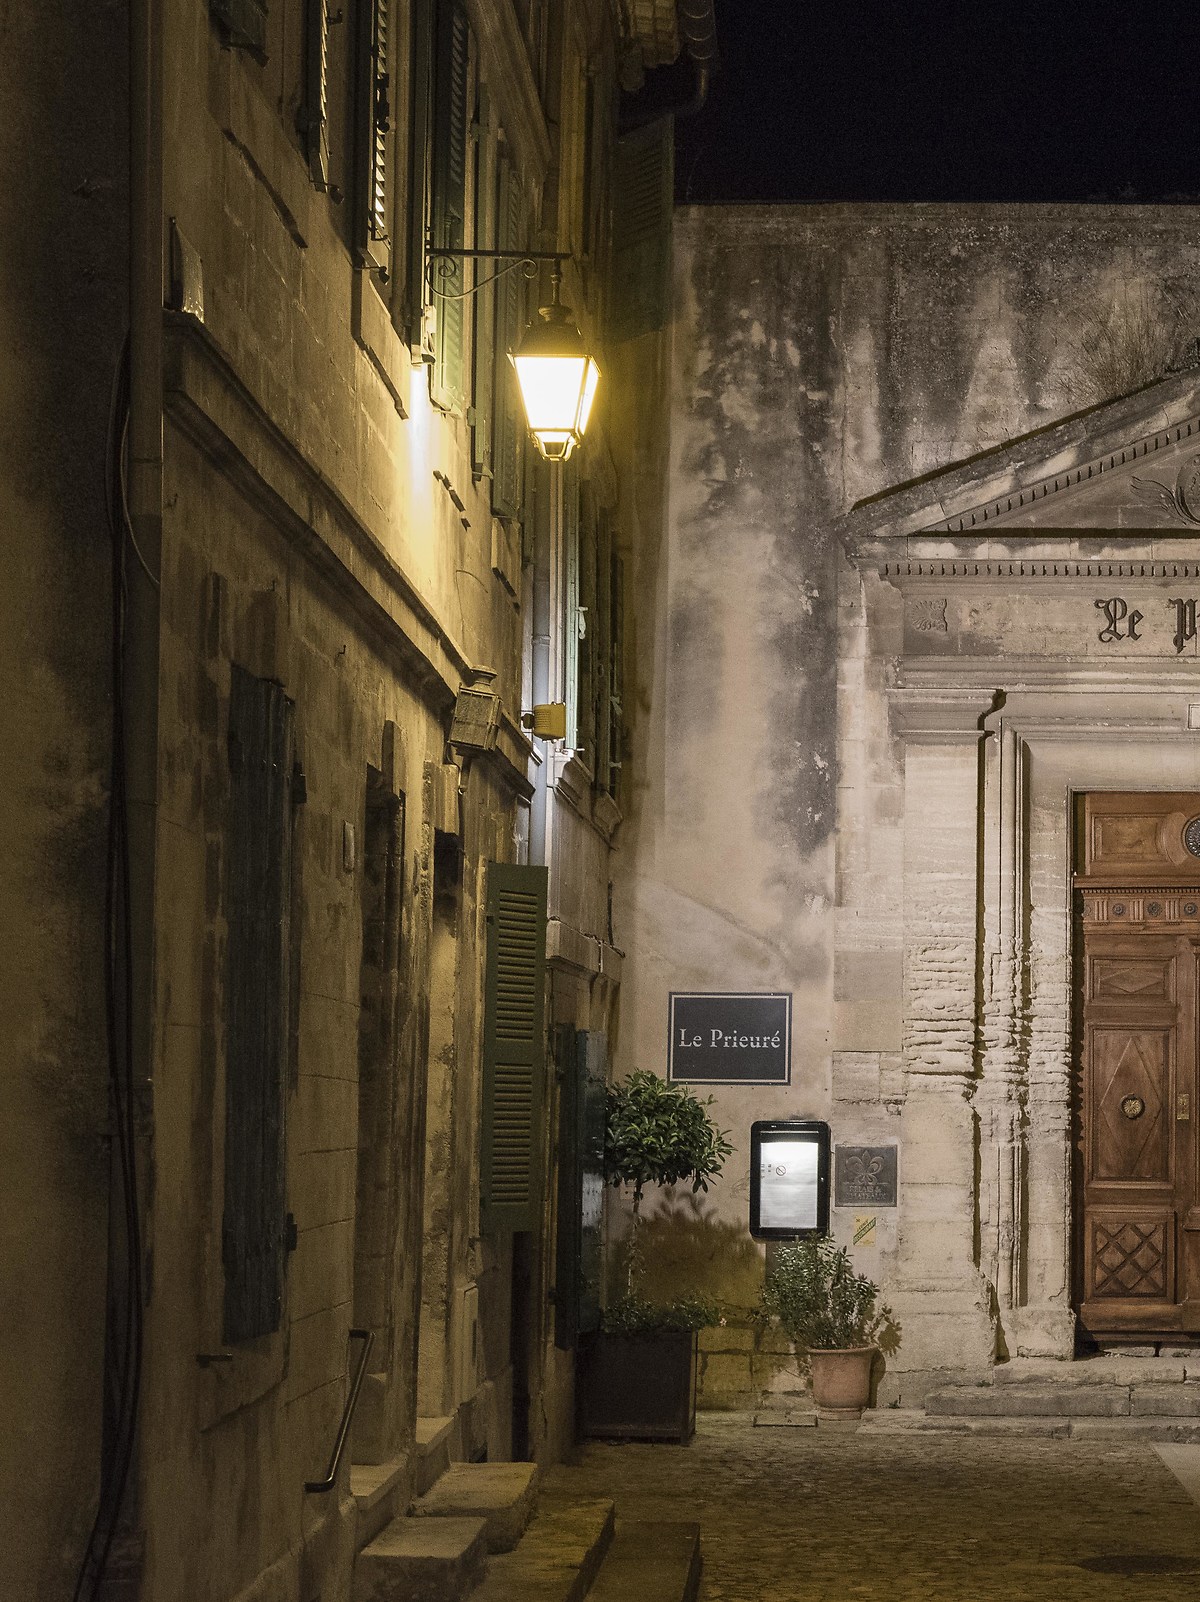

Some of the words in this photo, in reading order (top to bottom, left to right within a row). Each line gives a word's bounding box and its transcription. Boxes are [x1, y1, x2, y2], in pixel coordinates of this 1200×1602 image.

[1093, 597, 1144, 643] Le
[678, 1028, 702, 1047] Le
[709, 1028, 781, 1049] Prieuré
